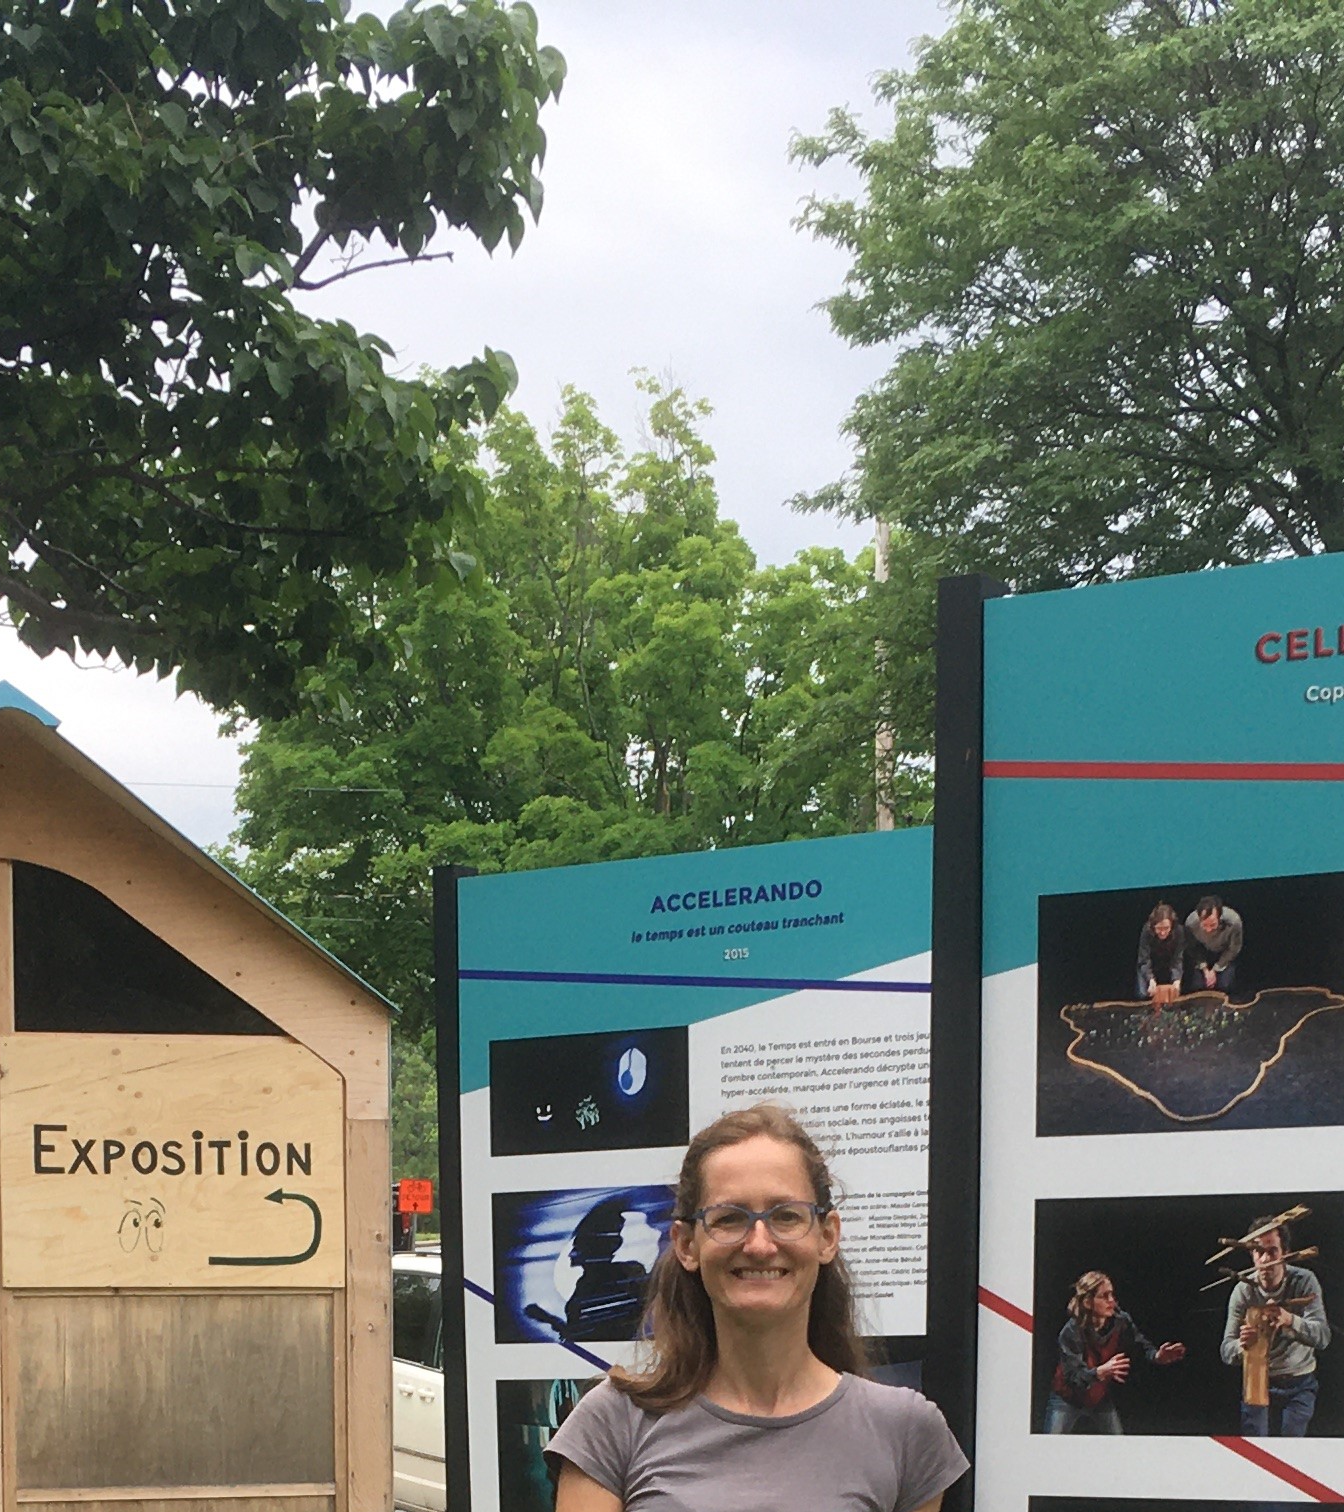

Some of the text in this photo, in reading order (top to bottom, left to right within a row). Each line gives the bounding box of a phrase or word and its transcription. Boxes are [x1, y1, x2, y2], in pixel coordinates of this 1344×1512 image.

[650, 879, 822, 914] ACCELERANDO
[631, 912, 844, 943] le temps est un couteau tranchant
[722, 947, 750, 961] 2015
